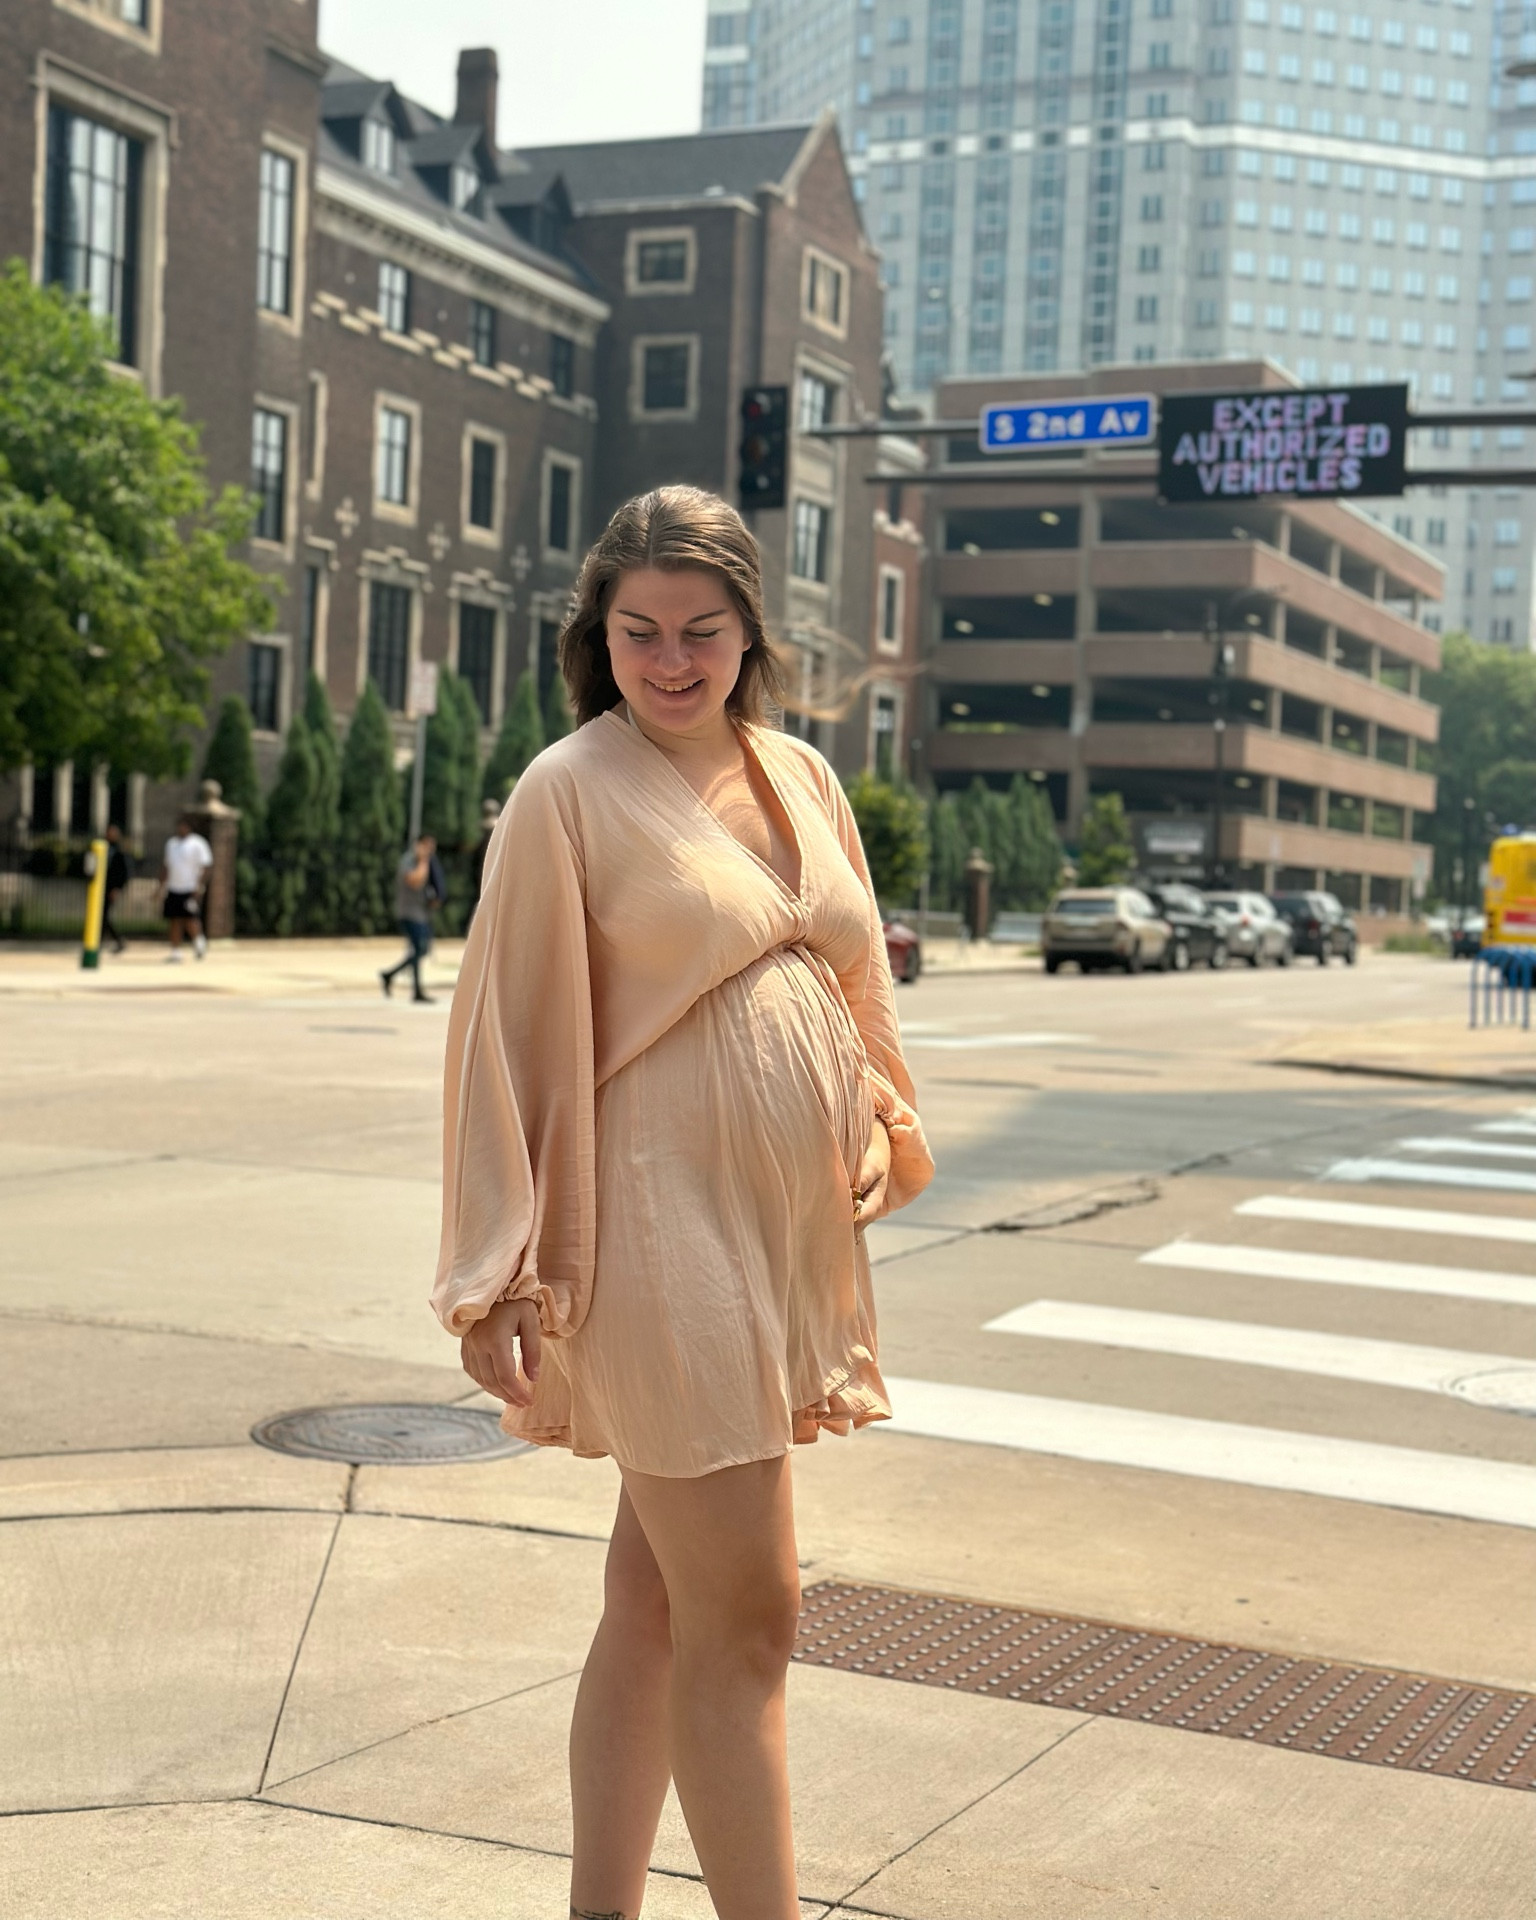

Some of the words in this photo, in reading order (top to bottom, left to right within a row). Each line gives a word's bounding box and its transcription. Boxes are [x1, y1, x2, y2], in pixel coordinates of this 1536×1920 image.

[994, 413, 1015, 441] S
[1026, 409, 1086, 440] 2nd
[1098, 406, 1141, 434] Av
[1213, 393, 1349, 430] EXCEPT
[1172, 422, 1390, 465] AUTHORIZED
[1197, 457, 1362, 494] VEHICLES
